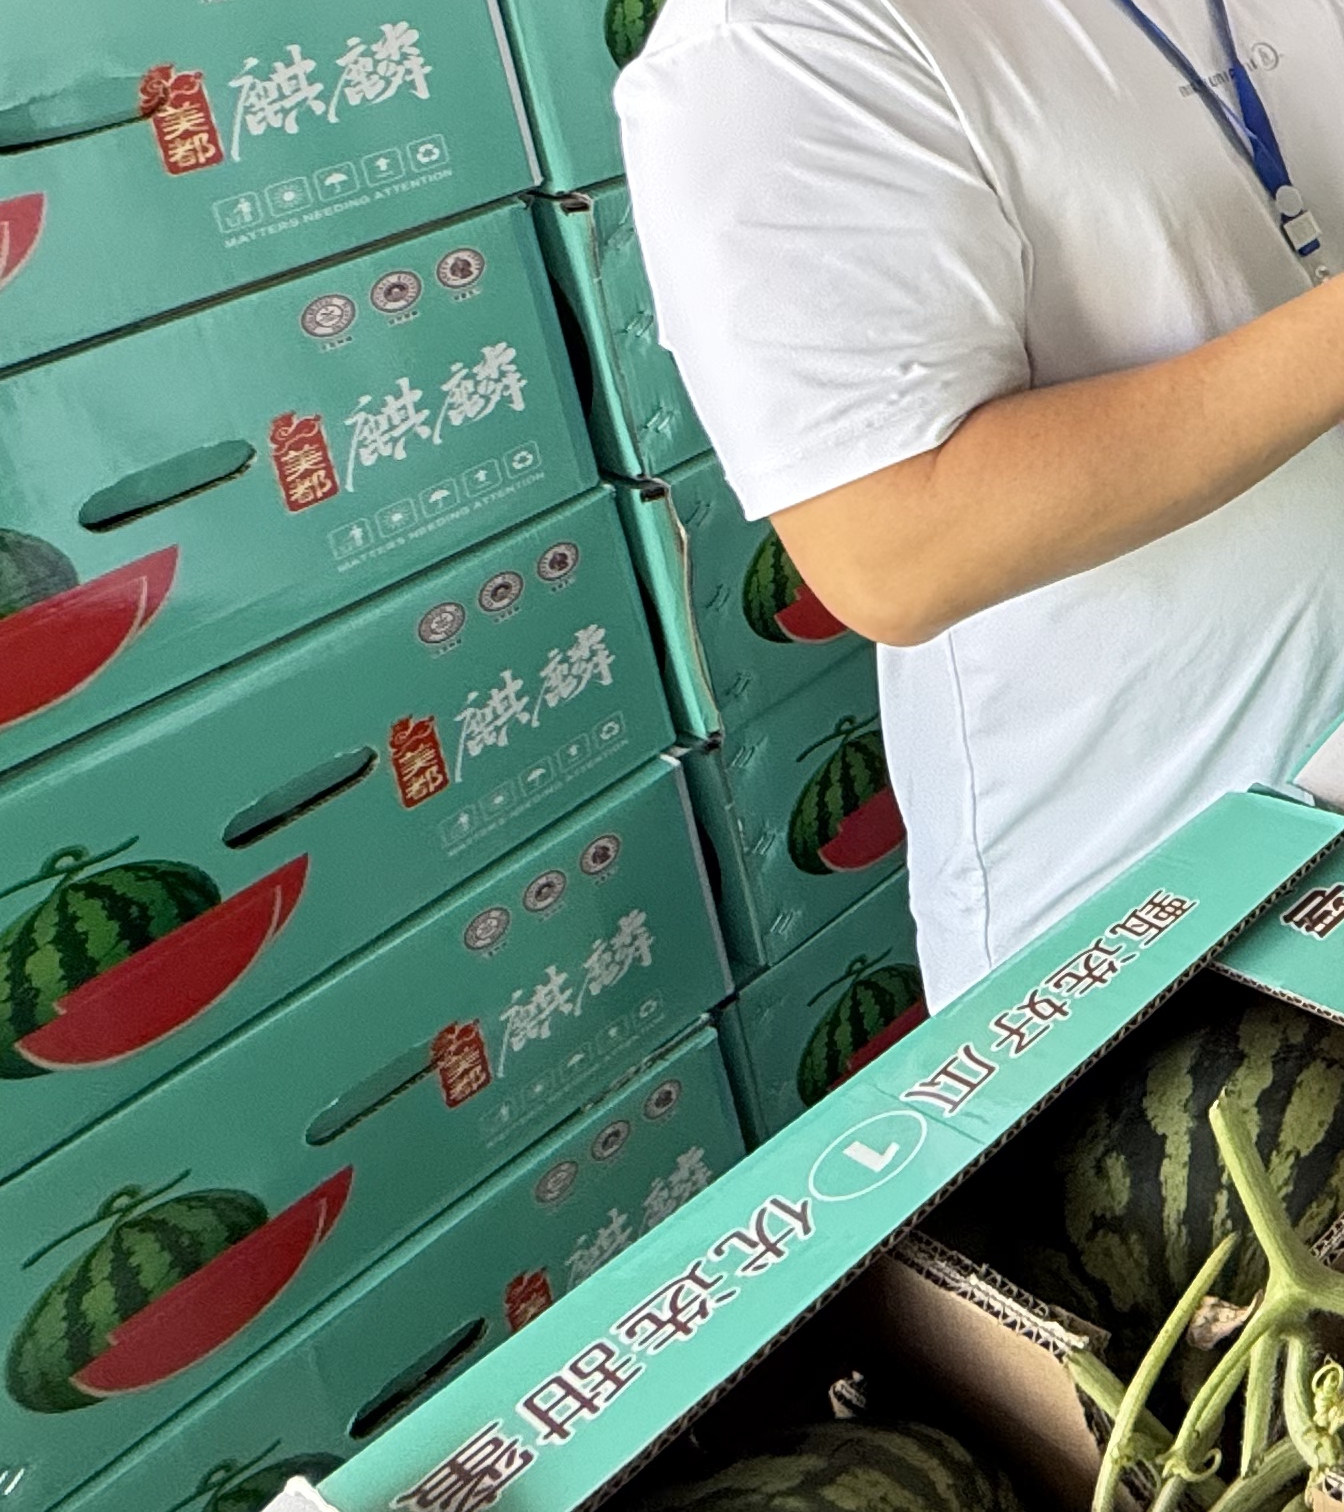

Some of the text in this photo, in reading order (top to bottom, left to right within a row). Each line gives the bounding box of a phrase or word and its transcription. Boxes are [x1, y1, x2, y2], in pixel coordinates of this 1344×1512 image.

[158, 102, 215, 168] 美都
[229, 21, 432, 163] 麒麟
[344, 342, 528, 493] 麒麟
[454, 624, 616, 784] 麒麟
[904, 889, 1195, 1115] 甄选好瓜
[393, 1196, 814, 1512] 优选甜蜜
